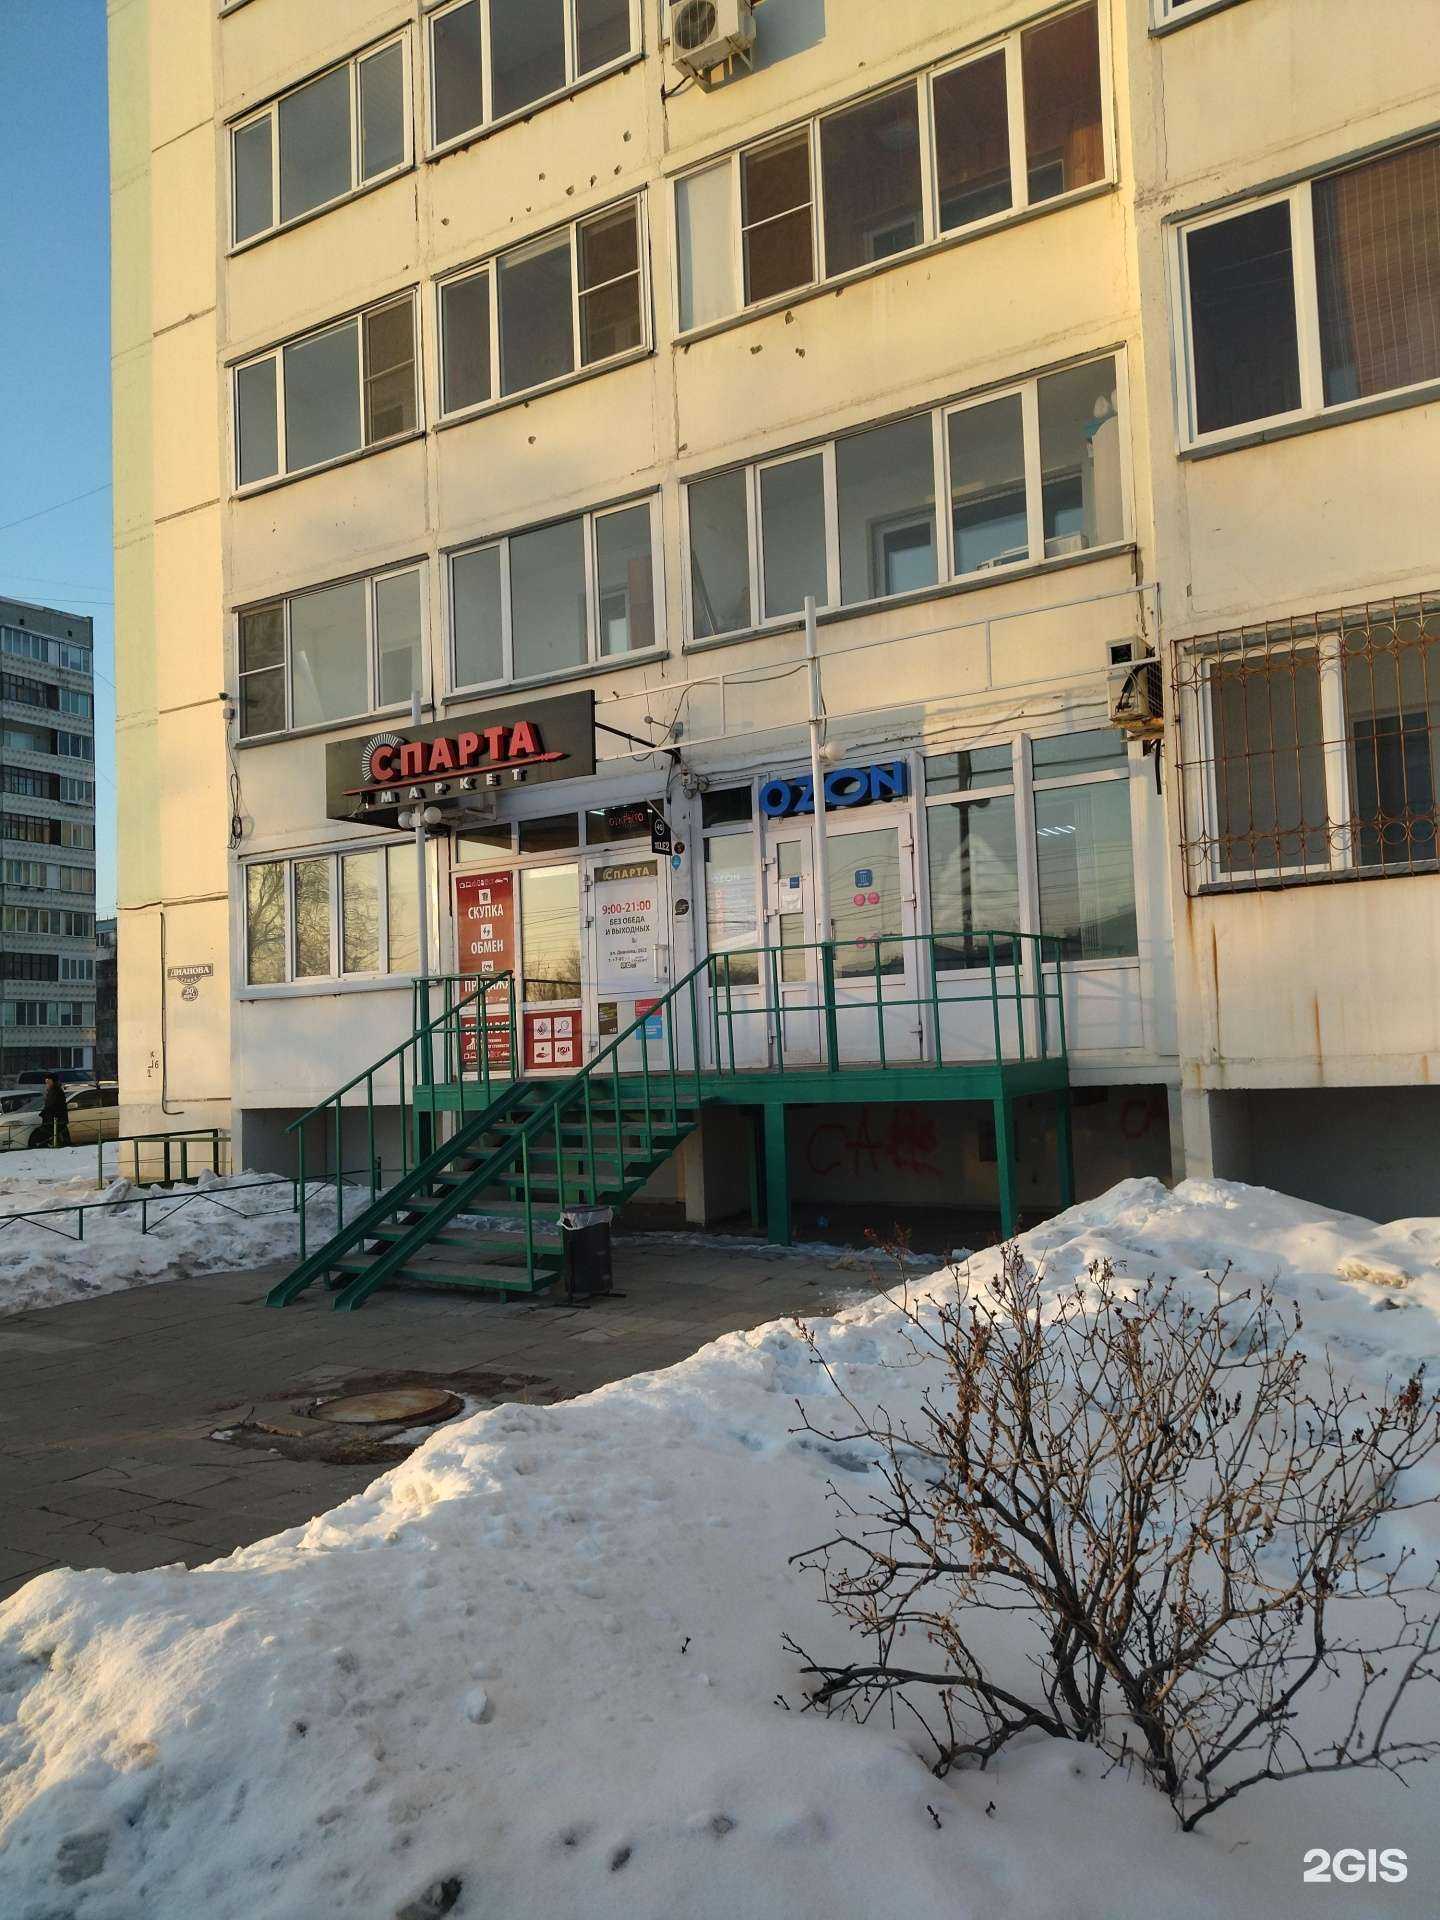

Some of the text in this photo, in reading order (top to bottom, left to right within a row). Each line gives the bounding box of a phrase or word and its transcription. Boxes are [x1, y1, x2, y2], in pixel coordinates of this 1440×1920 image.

[369, 720, 537, 781] СПАРТА
[381, 768, 523, 803] МАРКЕТ
[760, 761, 907, 816] OZON
[604, 866, 650, 880] СПАРТА
[468, 904, 504, 919] СКУПКА
[602, 900, 651, 914] 9:00-21:00
[622, 916, 645, 924] ОБЕДА
[611, 925, 650, 935] ВЫХОДНЫХ
[471, 940, 504, 954] ОБМЕН
[170, 966, 210, 976] ДИАНОВА
